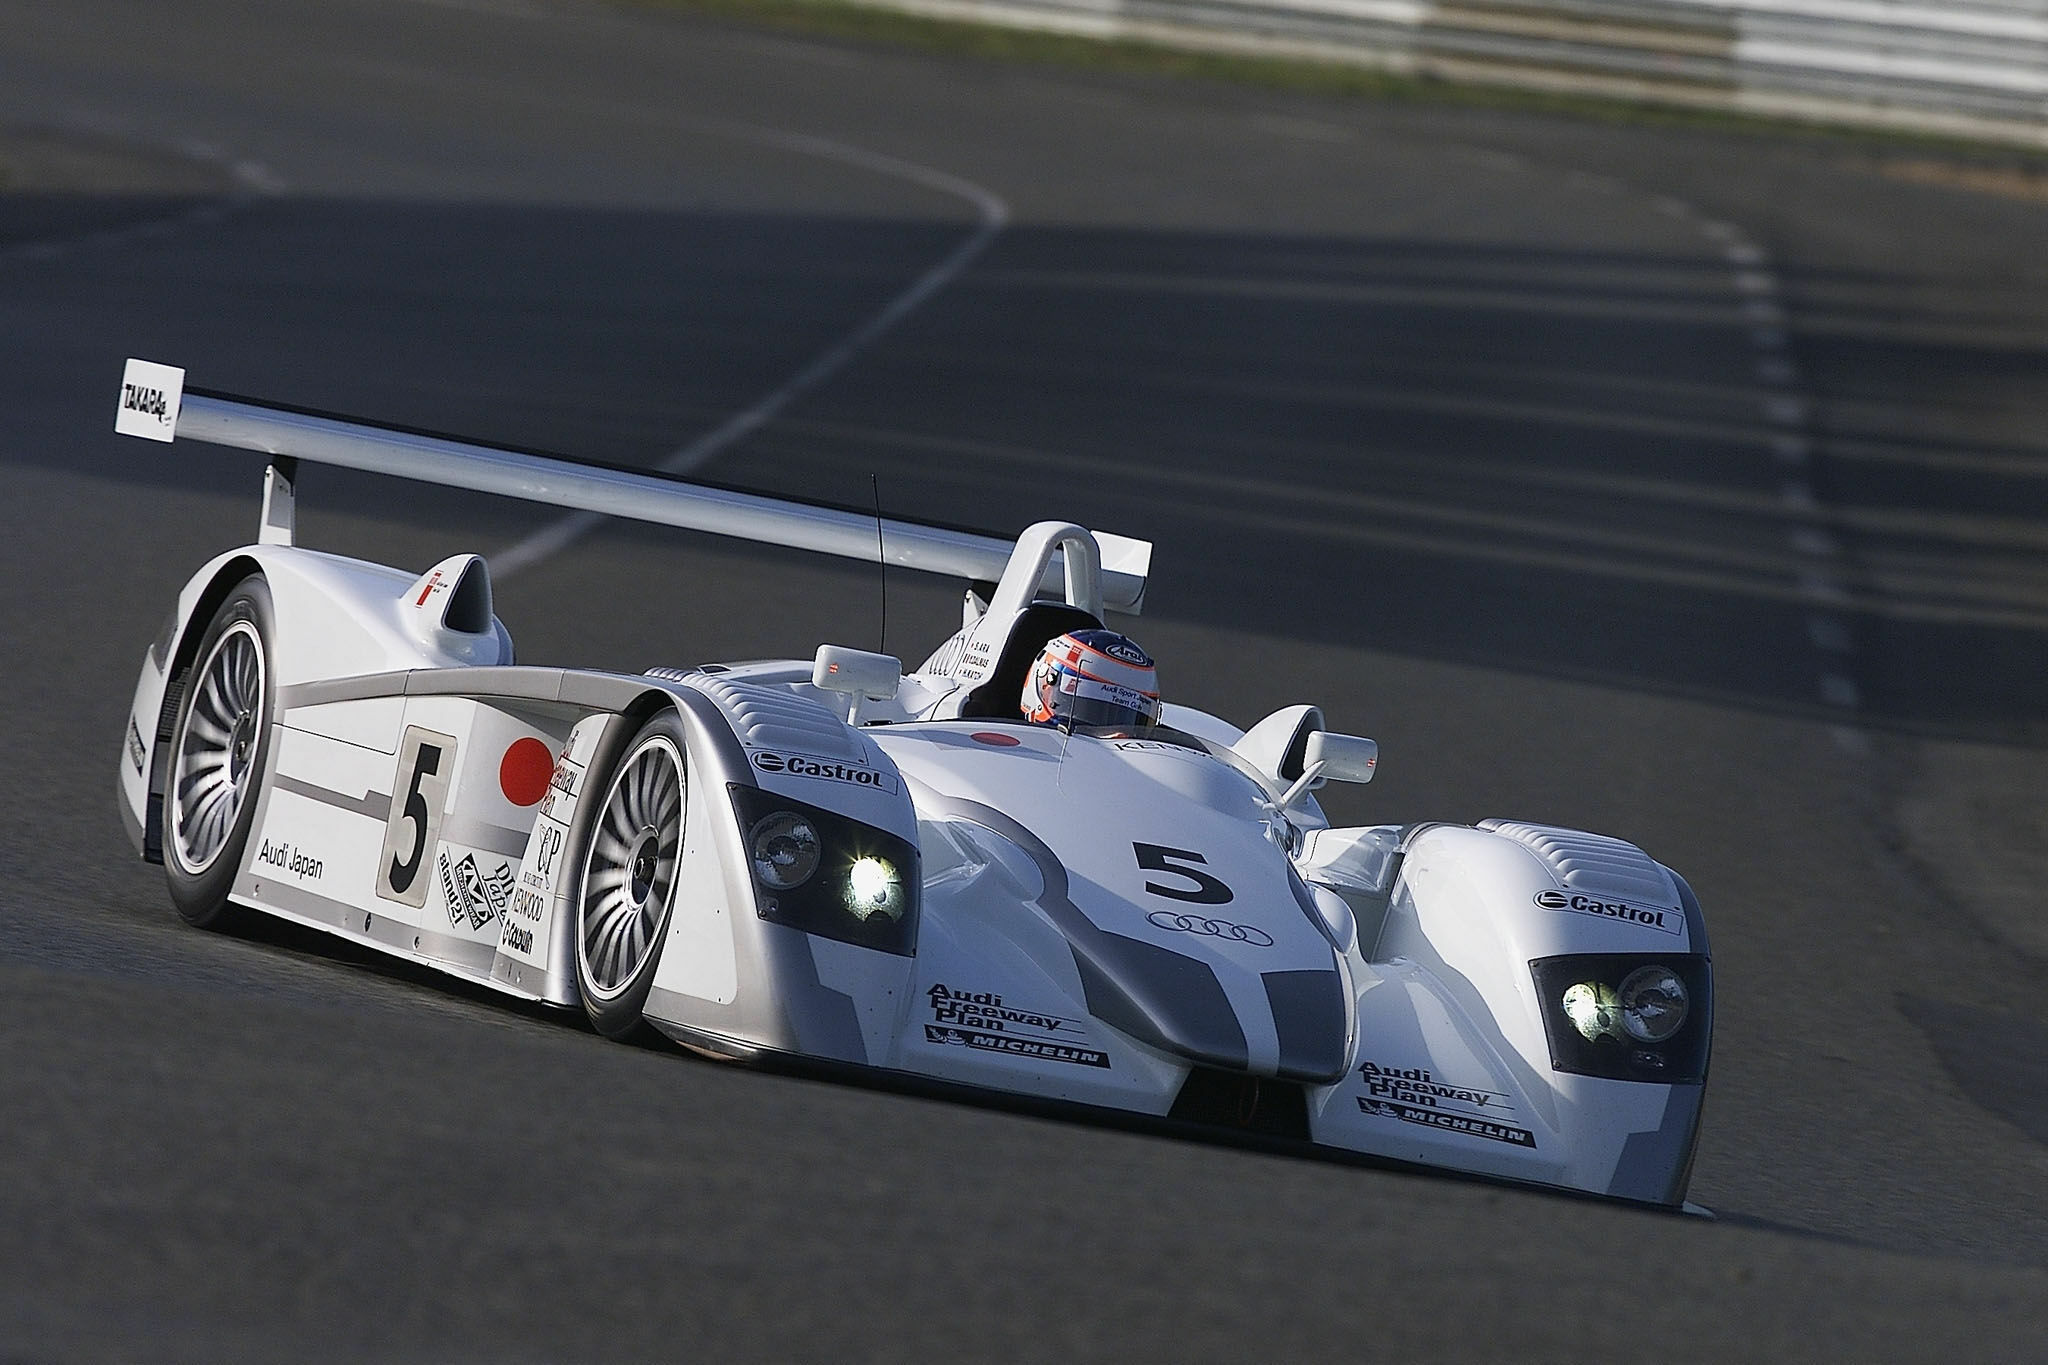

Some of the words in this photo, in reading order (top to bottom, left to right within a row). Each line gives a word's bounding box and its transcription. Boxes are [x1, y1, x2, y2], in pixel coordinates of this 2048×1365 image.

[1110, 646, 1144, 662] Arai
[1101, 685, 1118, 694] Audi
[1119, 688, 1137, 699] Sport
[1112, 695, 1130, 706] Team
[787, 757, 883, 787] Castrol
[389, 743, 443, 893] 5
[259, 838, 289, 868] Audi
[289, 847, 323, 880] Japan
[1132, 842, 1234, 904] 5
[1570, 895, 1666, 928] Castrol
[926, 984, 1001, 1007] Audi
[930, 995, 1063, 1030] Freeway
[936, 1008, 1005, 1031] Plan
[972, 1035, 1100, 1063] MICHELIN
[1358, 1061, 1431, 1083] Audi
[1363, 1071, 1491, 1107] Freeway
[1370, 1083, 1437, 1107] Plan
[1404, 1109, 1526, 1142] MICHELIN
